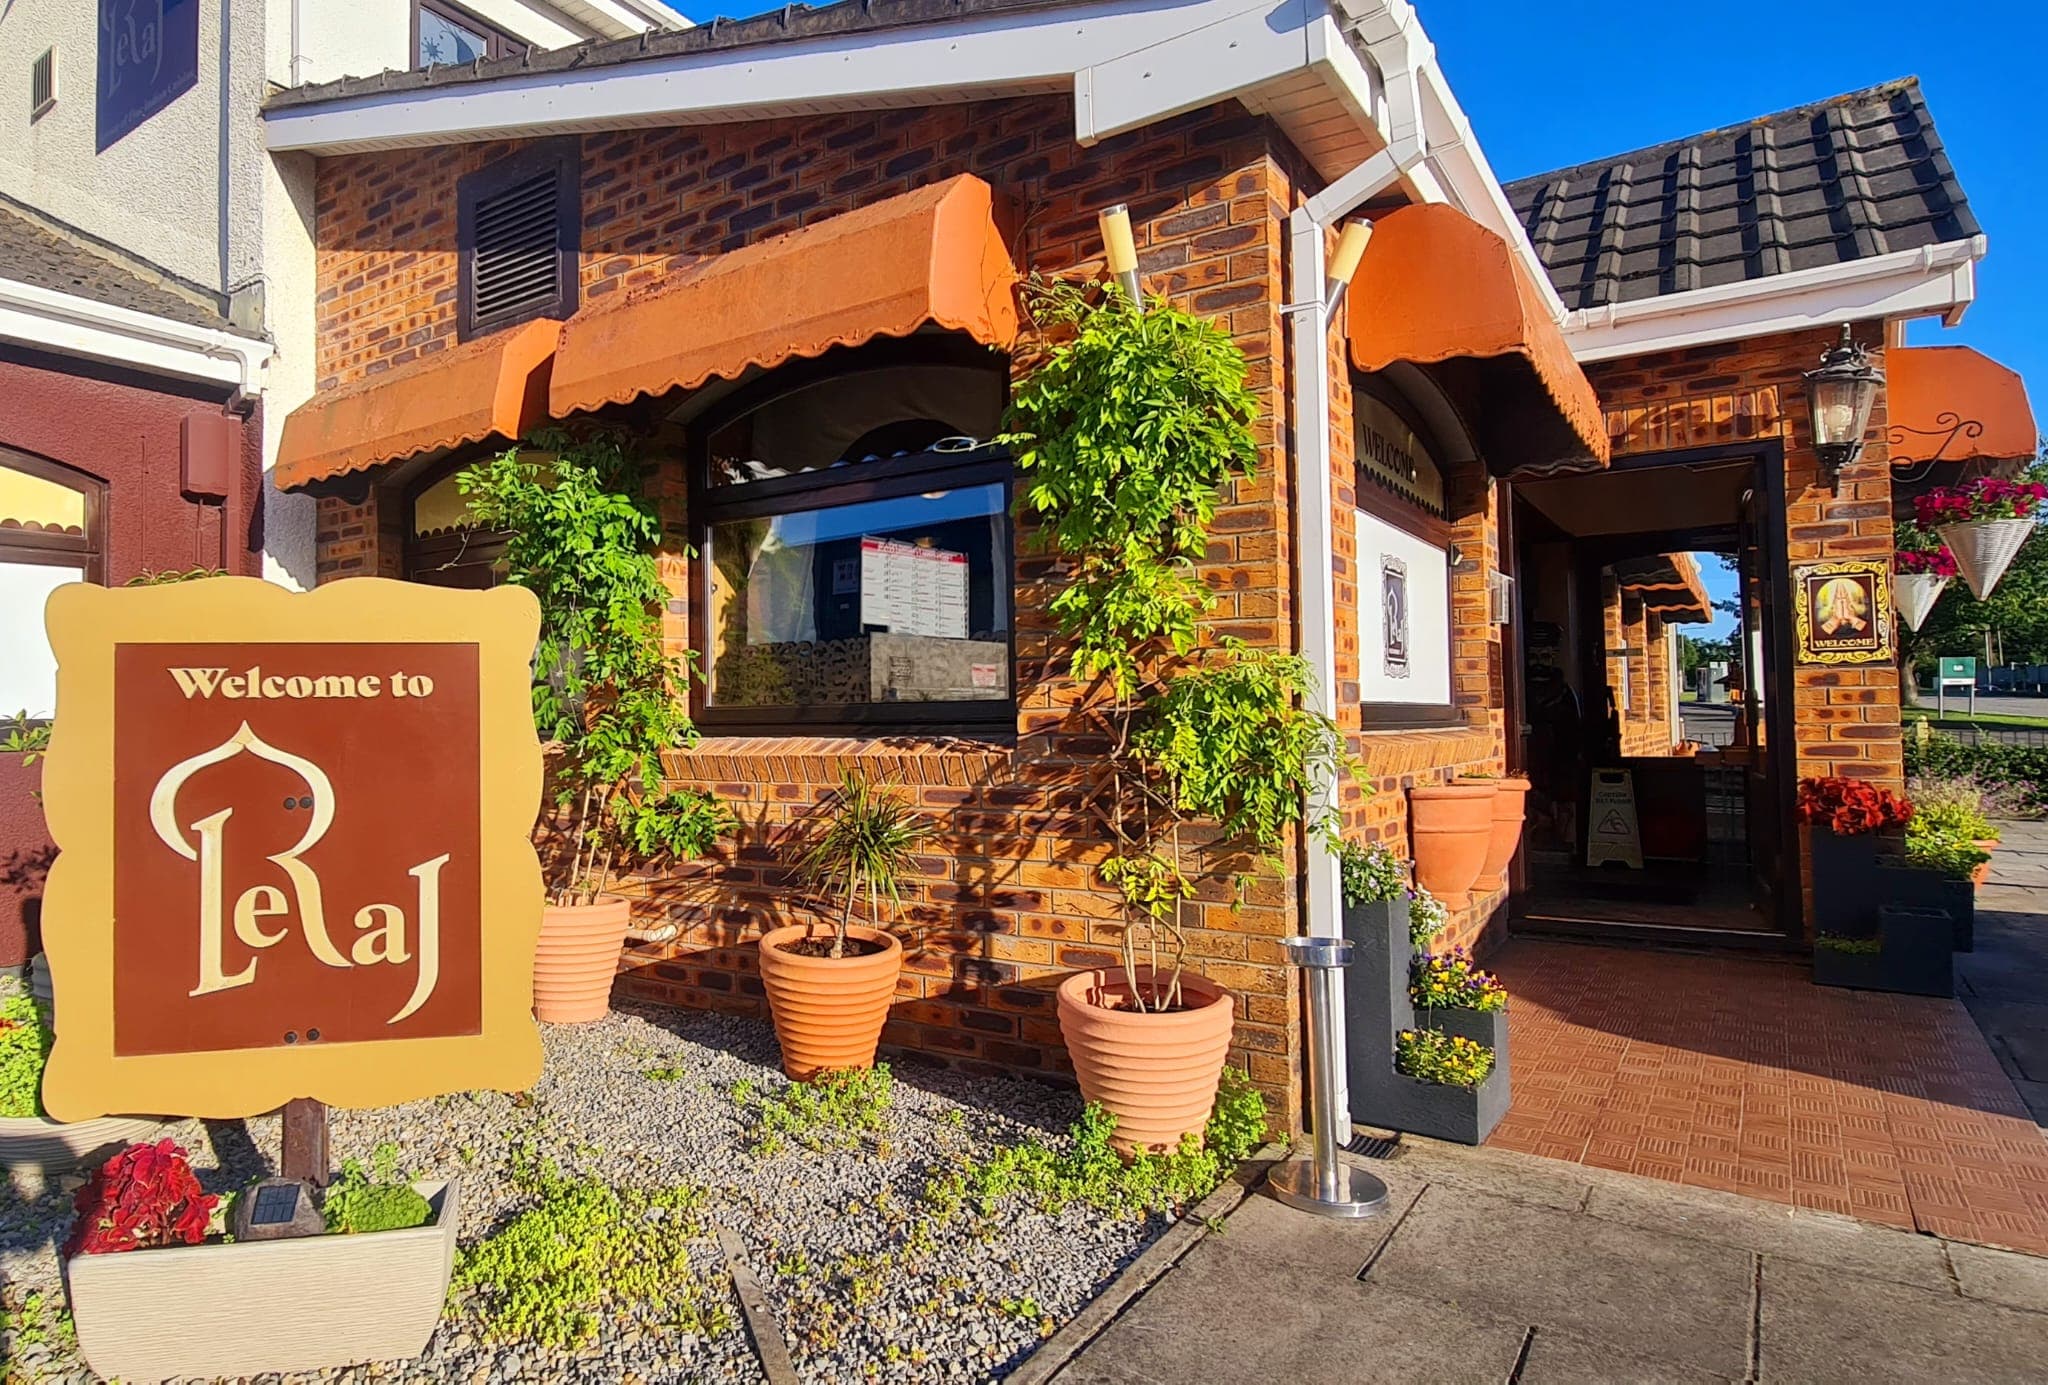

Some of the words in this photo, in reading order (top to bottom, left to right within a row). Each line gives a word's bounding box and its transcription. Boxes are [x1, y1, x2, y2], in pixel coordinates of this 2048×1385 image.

[1361, 422, 1416, 484] WELCOME
[1814, 638, 1874, 648] WELCOME
[167, 666, 380, 700] Welcome
[390, 670, 434, 698] to
